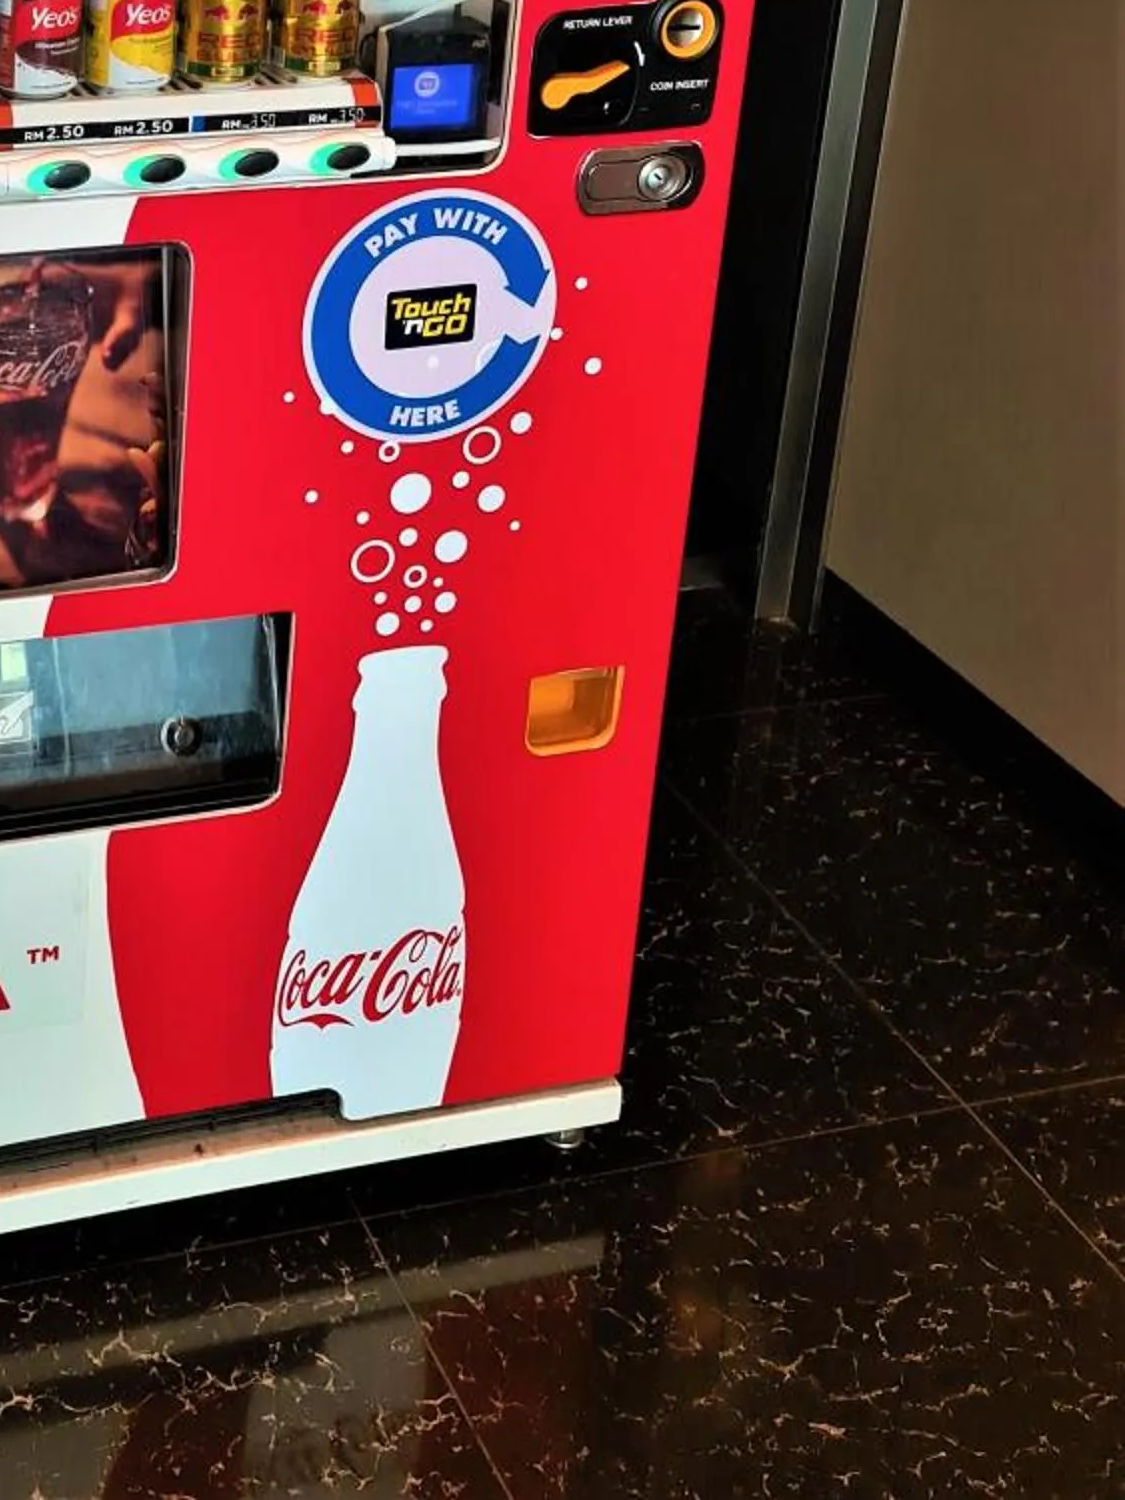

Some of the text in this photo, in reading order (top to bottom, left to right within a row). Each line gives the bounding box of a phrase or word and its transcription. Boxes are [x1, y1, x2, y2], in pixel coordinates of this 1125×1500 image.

[563, 15, 633, 30] RETURN LEVER
[650, 79, 710, 92] COIN INSERT
[46, 124, 85, 141] 2.50
[136, 119, 174, 134] 2.50
[364, 207, 508, 259] PAY WITH
[391, 292, 471, 321] Touch
[389, 400, 462, 428] HERE
